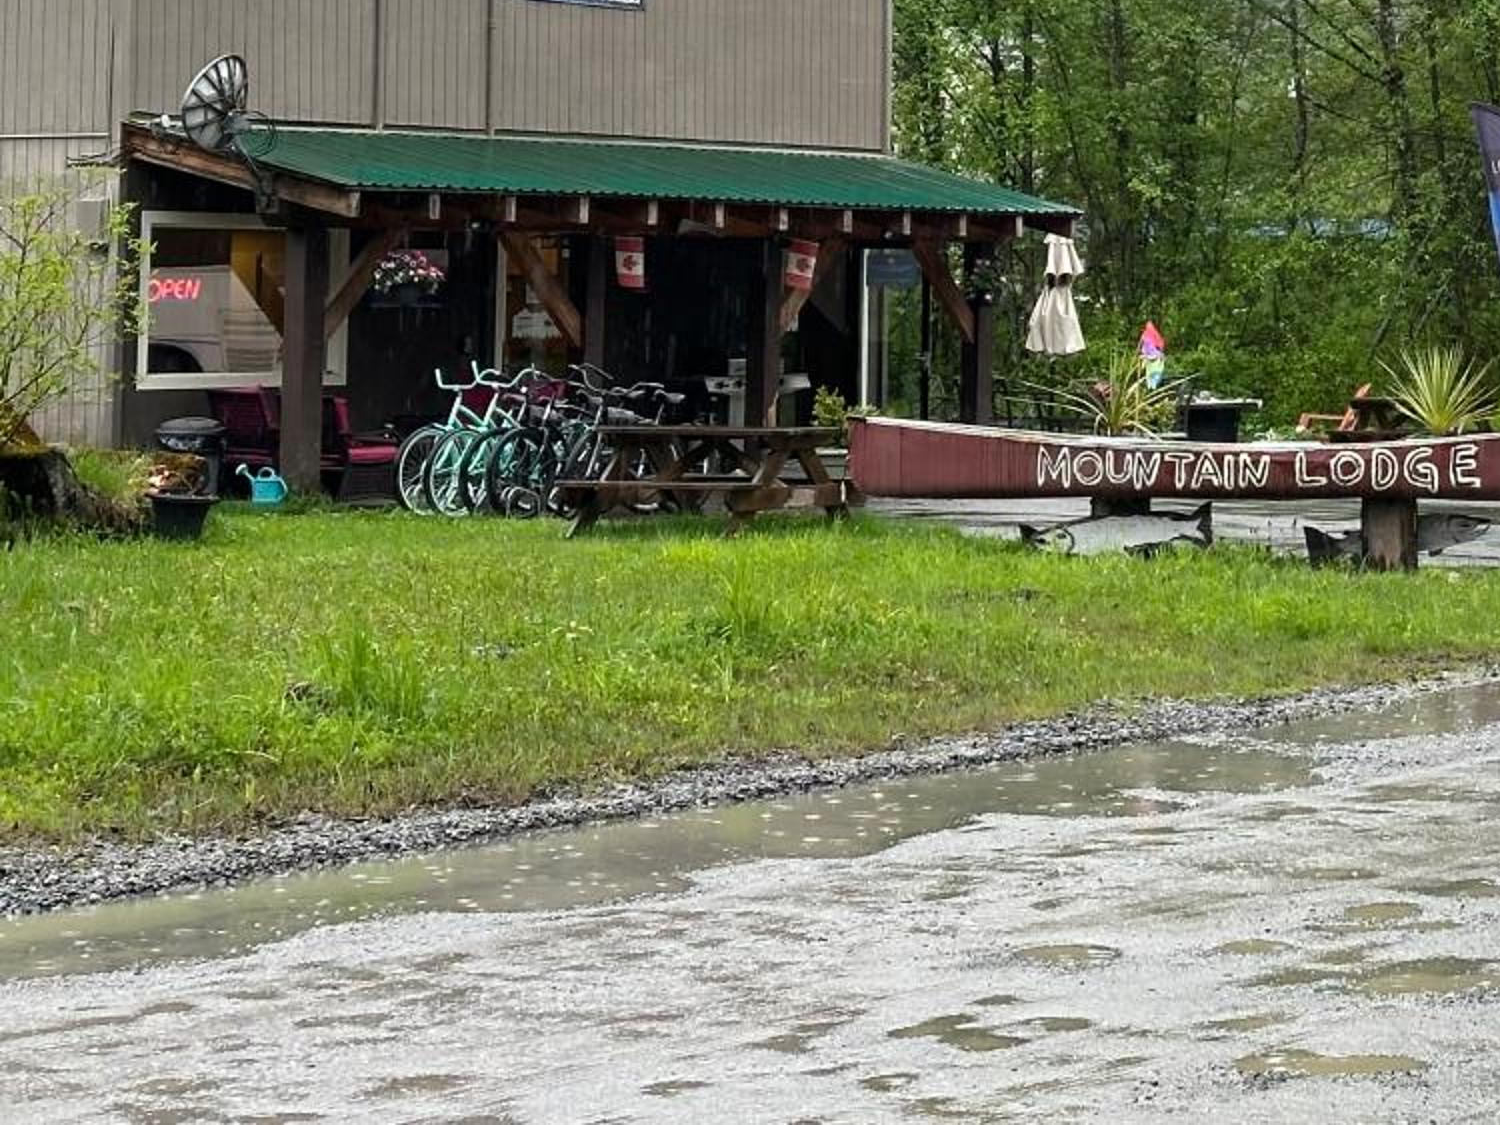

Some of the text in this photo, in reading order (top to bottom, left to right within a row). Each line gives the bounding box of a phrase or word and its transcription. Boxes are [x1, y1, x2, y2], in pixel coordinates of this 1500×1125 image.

[148, 278, 201, 302] OPEN
[1035, 442, 1482, 489] MOUNTAIN LODGE
